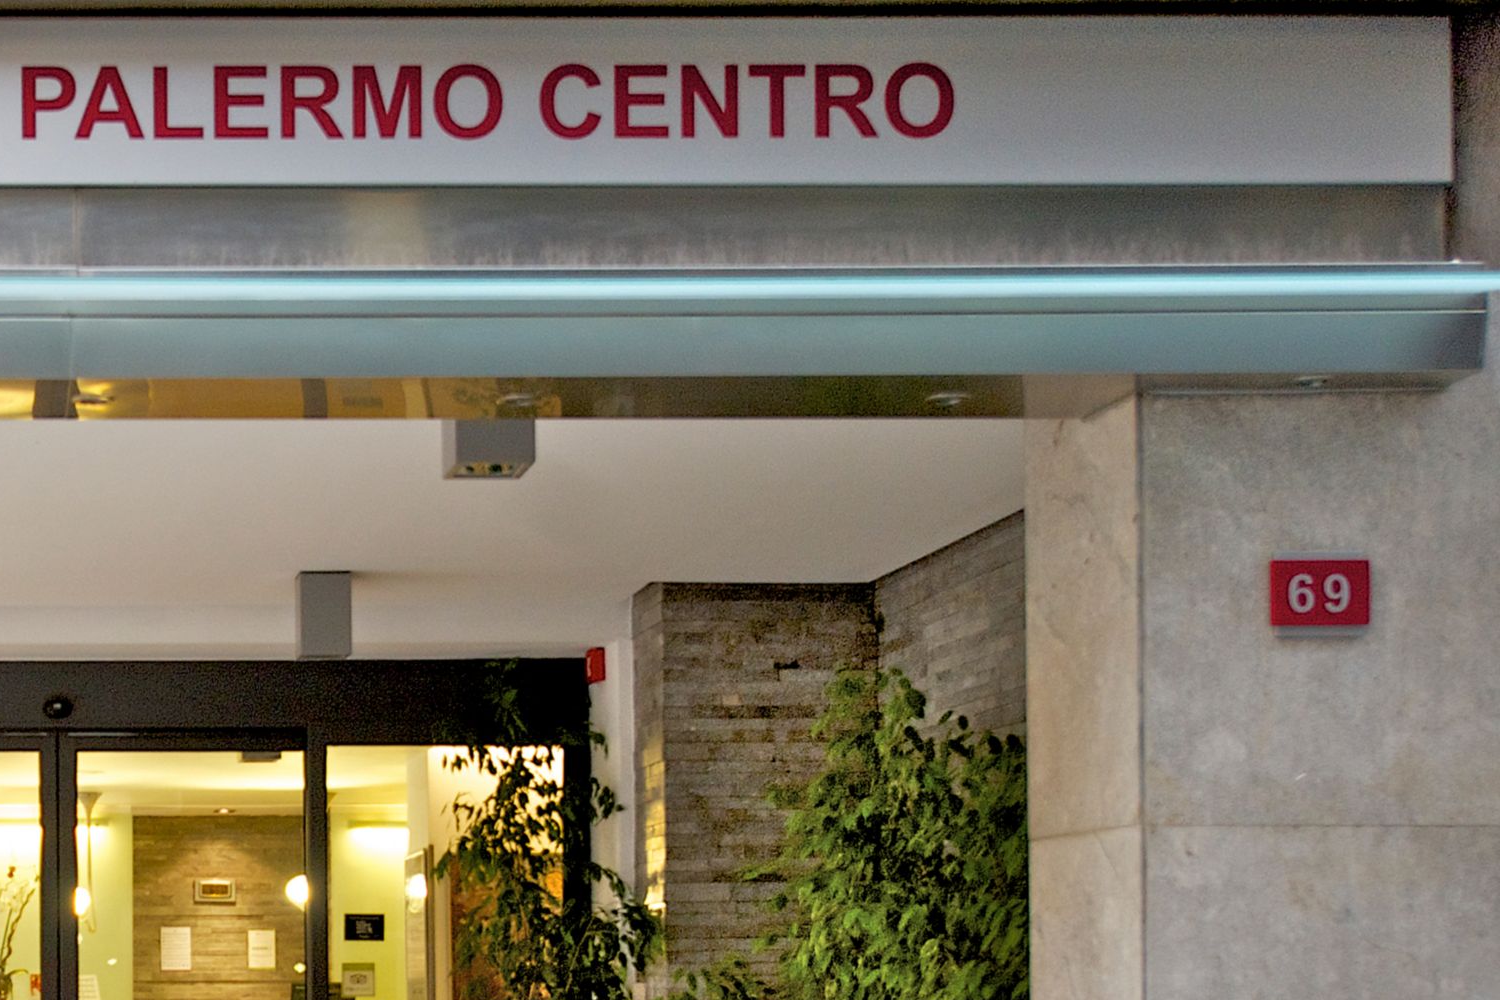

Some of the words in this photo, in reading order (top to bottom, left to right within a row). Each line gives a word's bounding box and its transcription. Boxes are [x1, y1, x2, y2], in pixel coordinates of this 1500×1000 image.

[20, 63, 503, 140] PALERMO
[538, 62, 956, 140] CENTRO
[1287, 573, 1351, 613] 69
